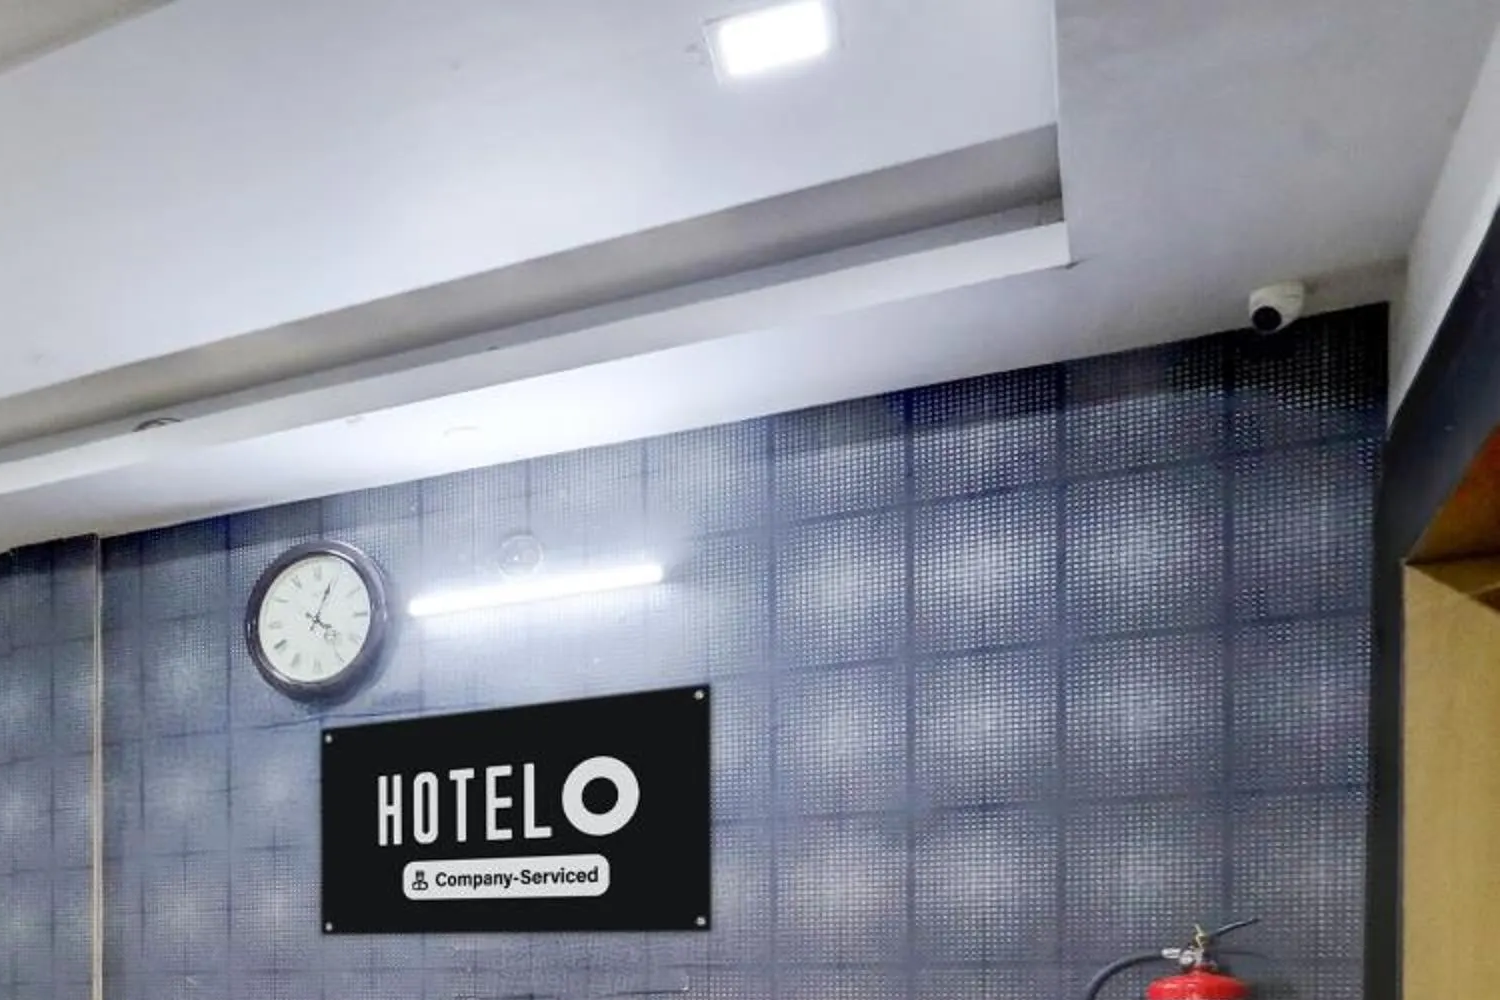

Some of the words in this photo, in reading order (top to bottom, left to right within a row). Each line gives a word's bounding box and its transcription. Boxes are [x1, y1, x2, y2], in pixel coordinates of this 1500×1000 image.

[378, 763, 552, 846] HOTEL
[561, 755, 640, 836] O
[435, 866, 599, 890] Company-Serviced
